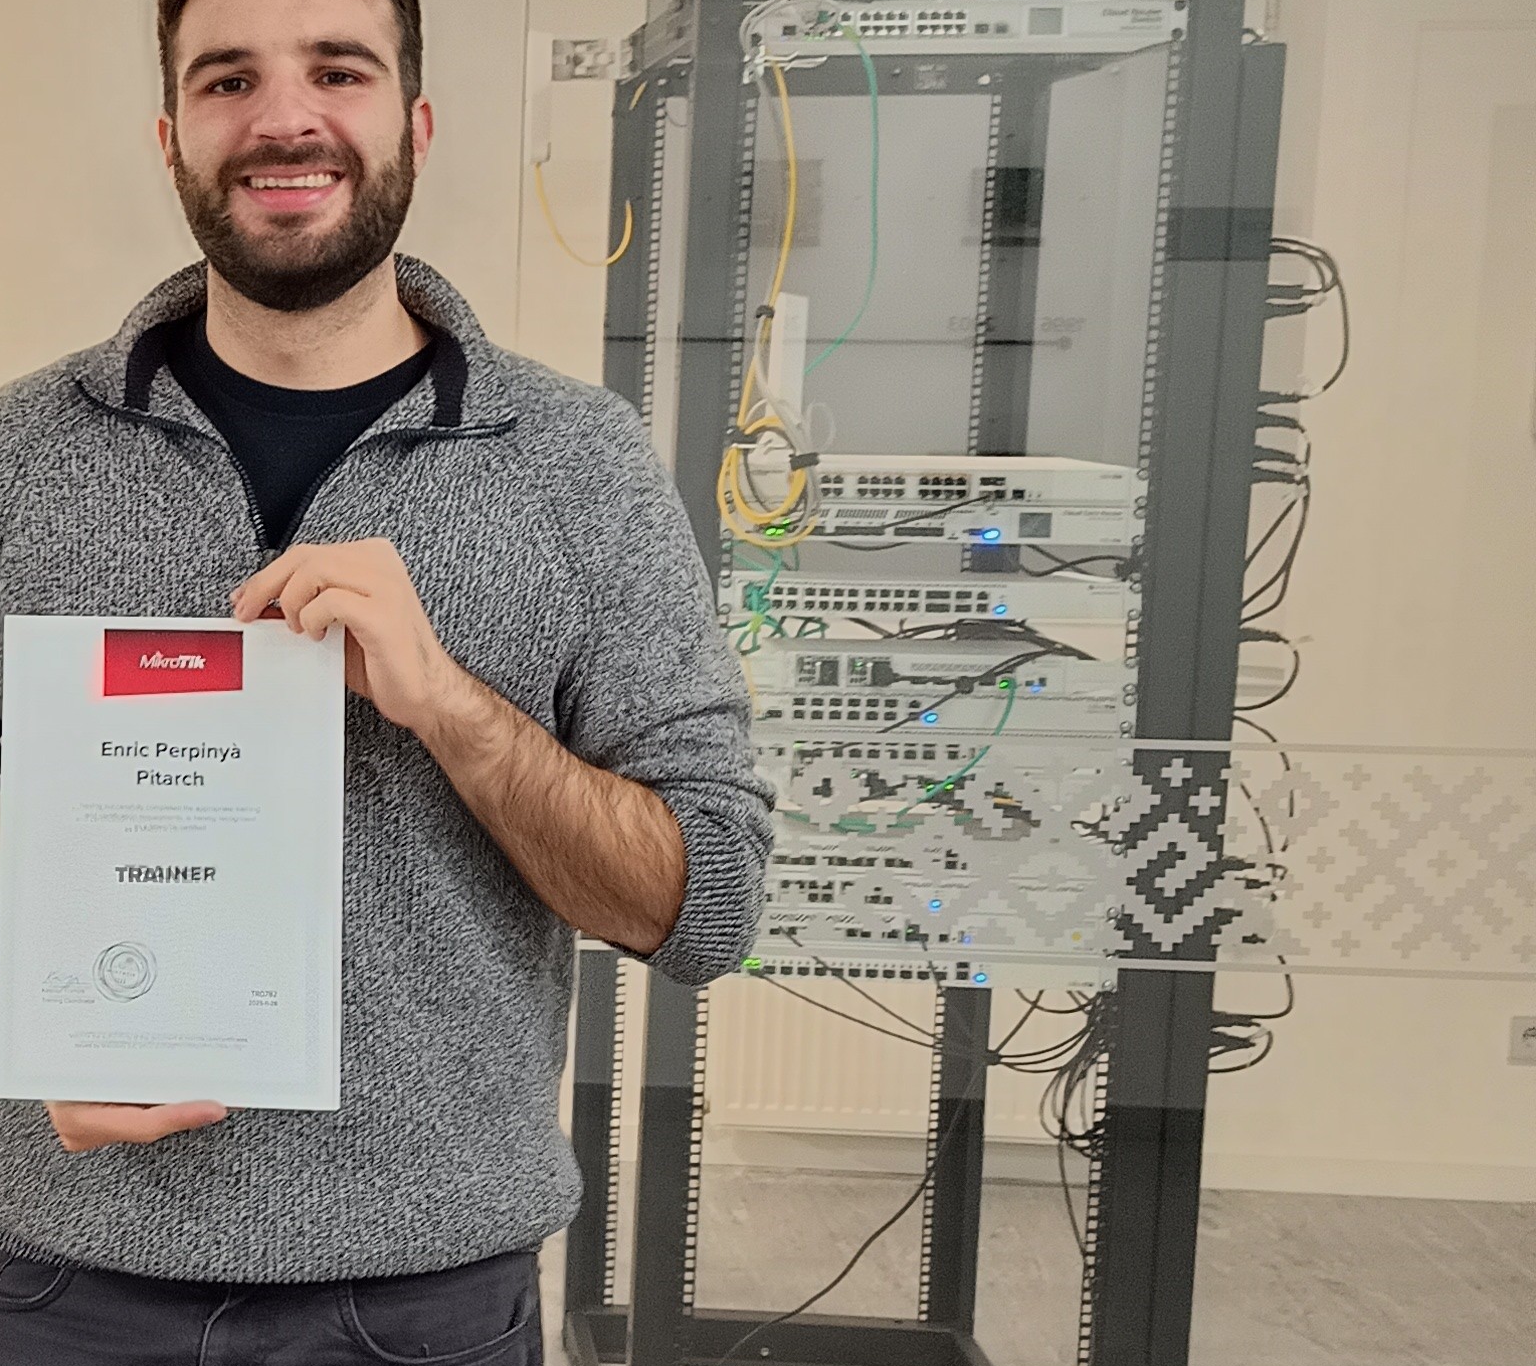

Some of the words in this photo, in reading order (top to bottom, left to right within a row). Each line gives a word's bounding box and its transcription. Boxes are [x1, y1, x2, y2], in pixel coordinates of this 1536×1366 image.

[139, 651, 206, 670] MikroTik
[101, 741, 149, 758] Enric
[155, 742, 241, 763] Perpinyà
[136, 770, 205, 786] Pitarch
[115, 866, 217, 884] TRAINER
